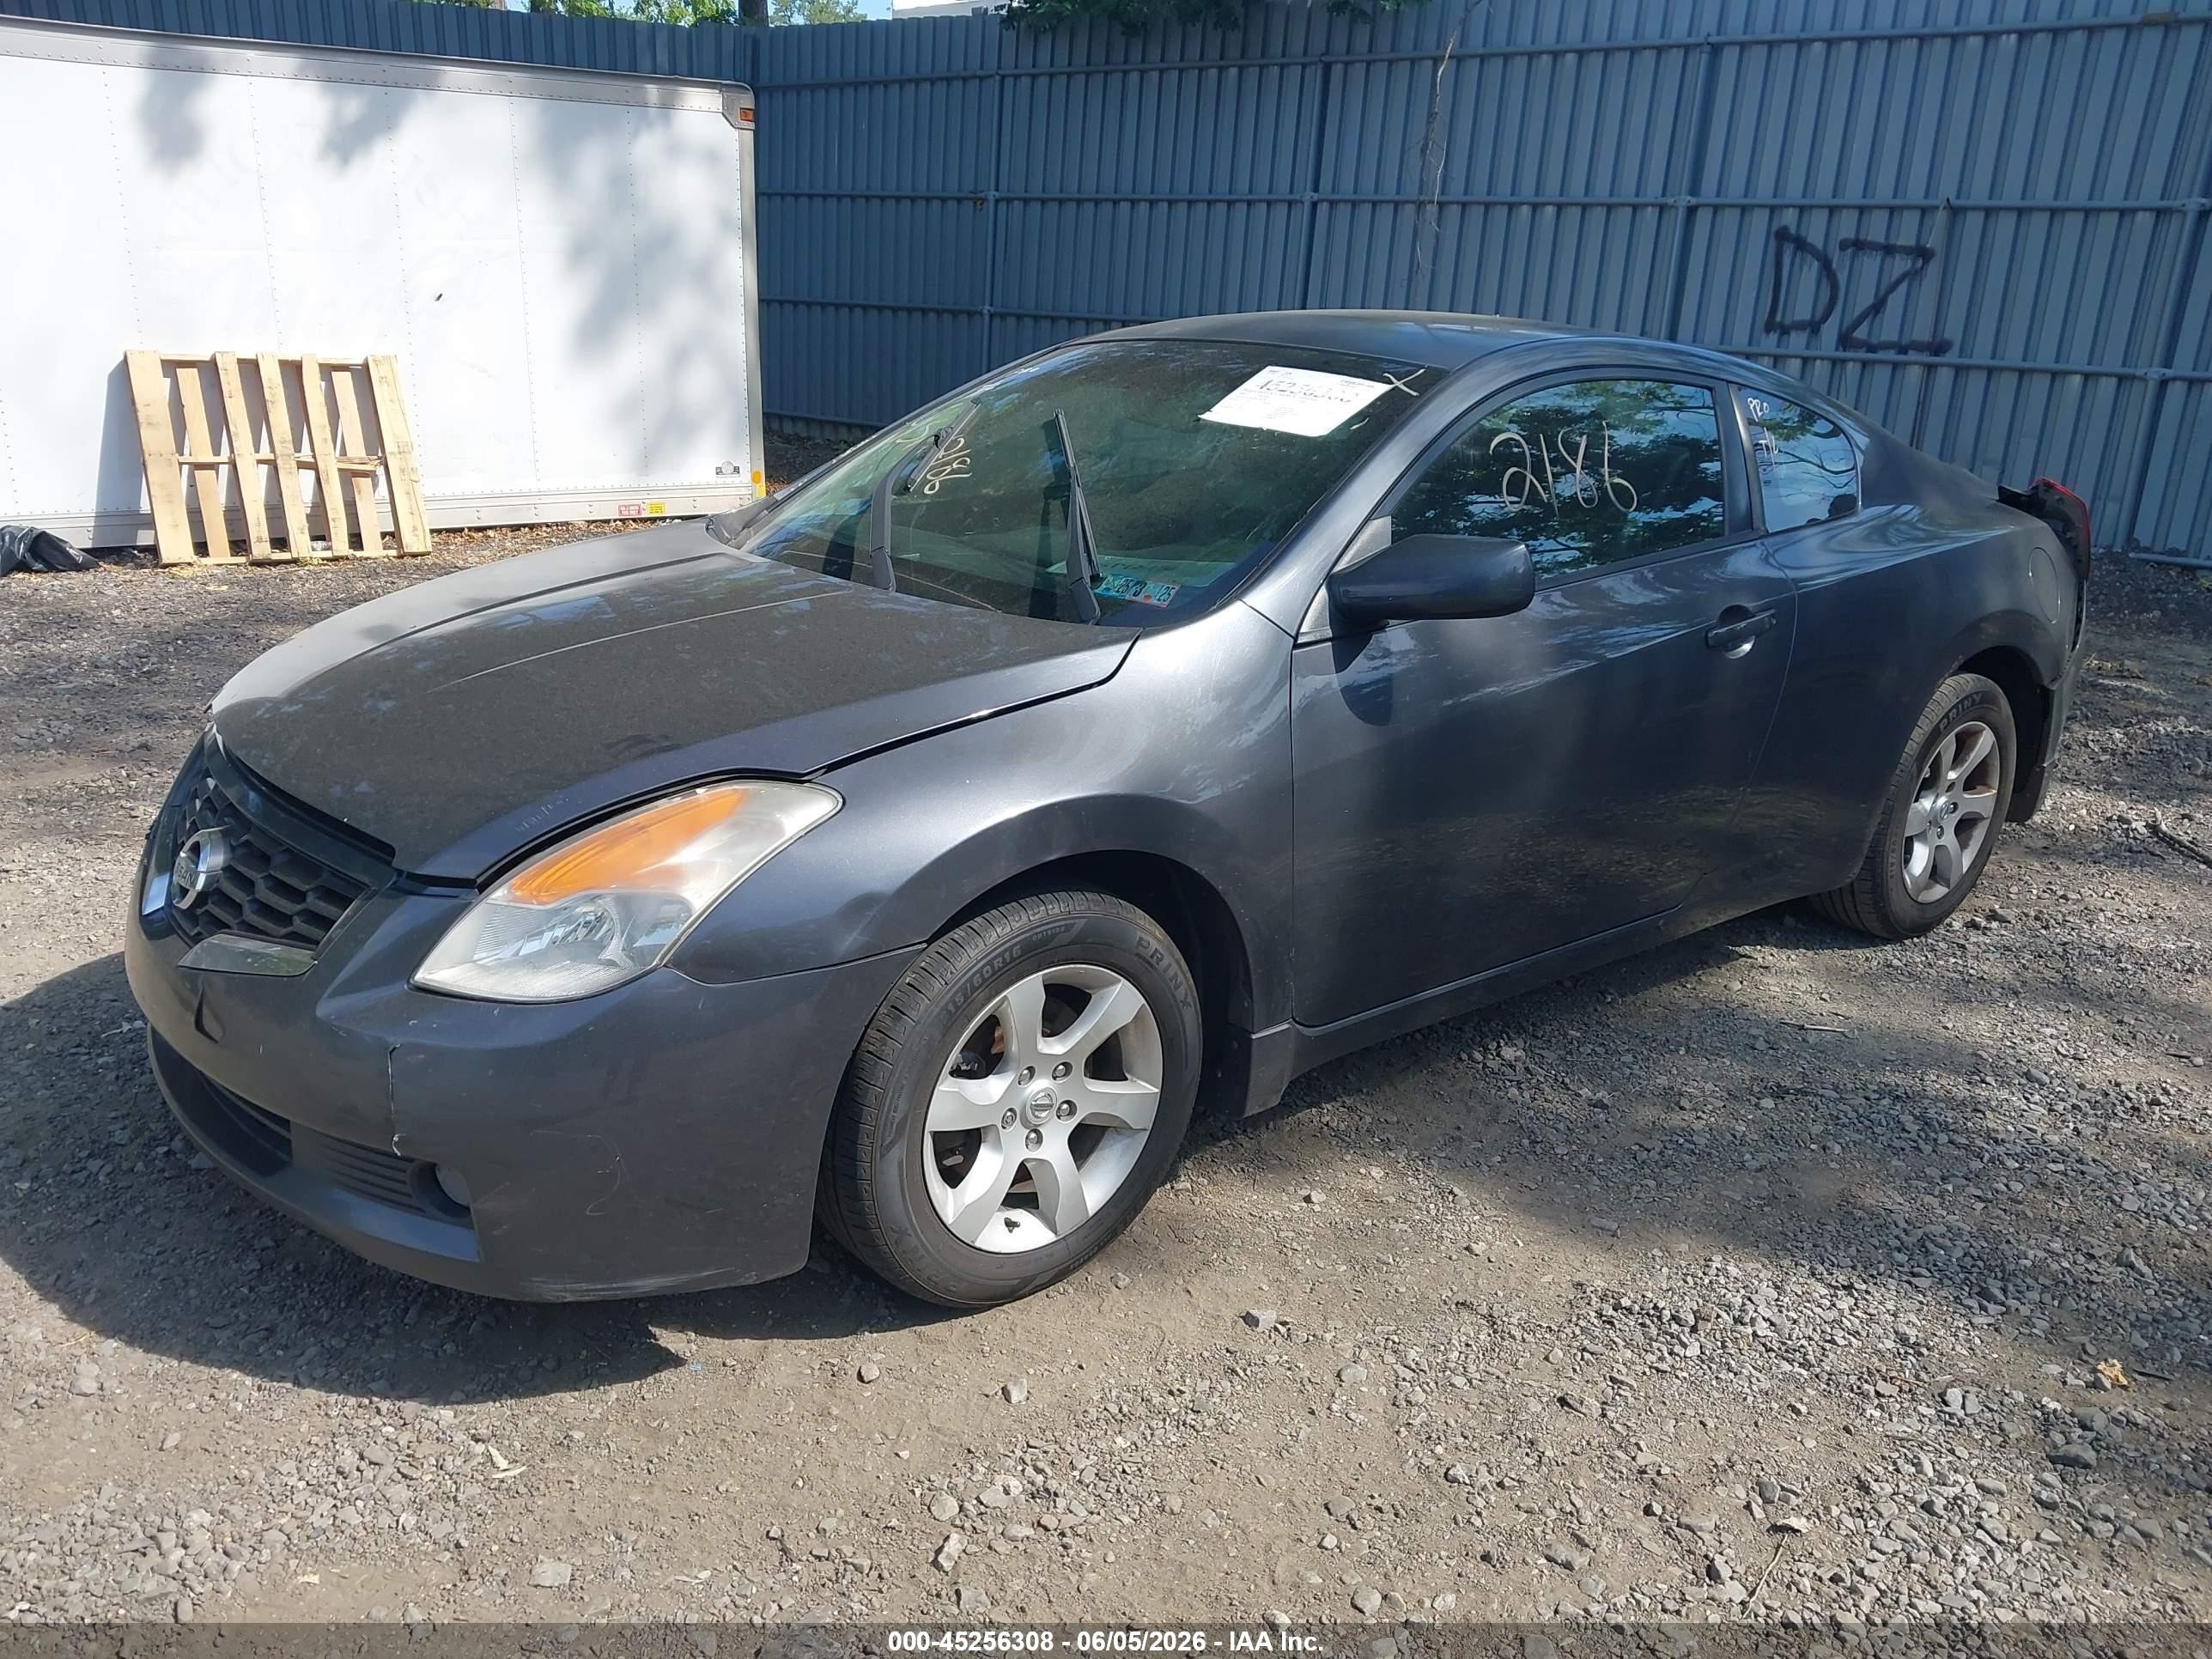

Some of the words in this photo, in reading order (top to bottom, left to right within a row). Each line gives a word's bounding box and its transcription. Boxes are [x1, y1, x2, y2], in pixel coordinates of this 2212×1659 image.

[1765, 225, 1954, 355] DZ
[1489, 420, 1638, 519] 2186
[1133, 931, 1192, 1010] PRINX
